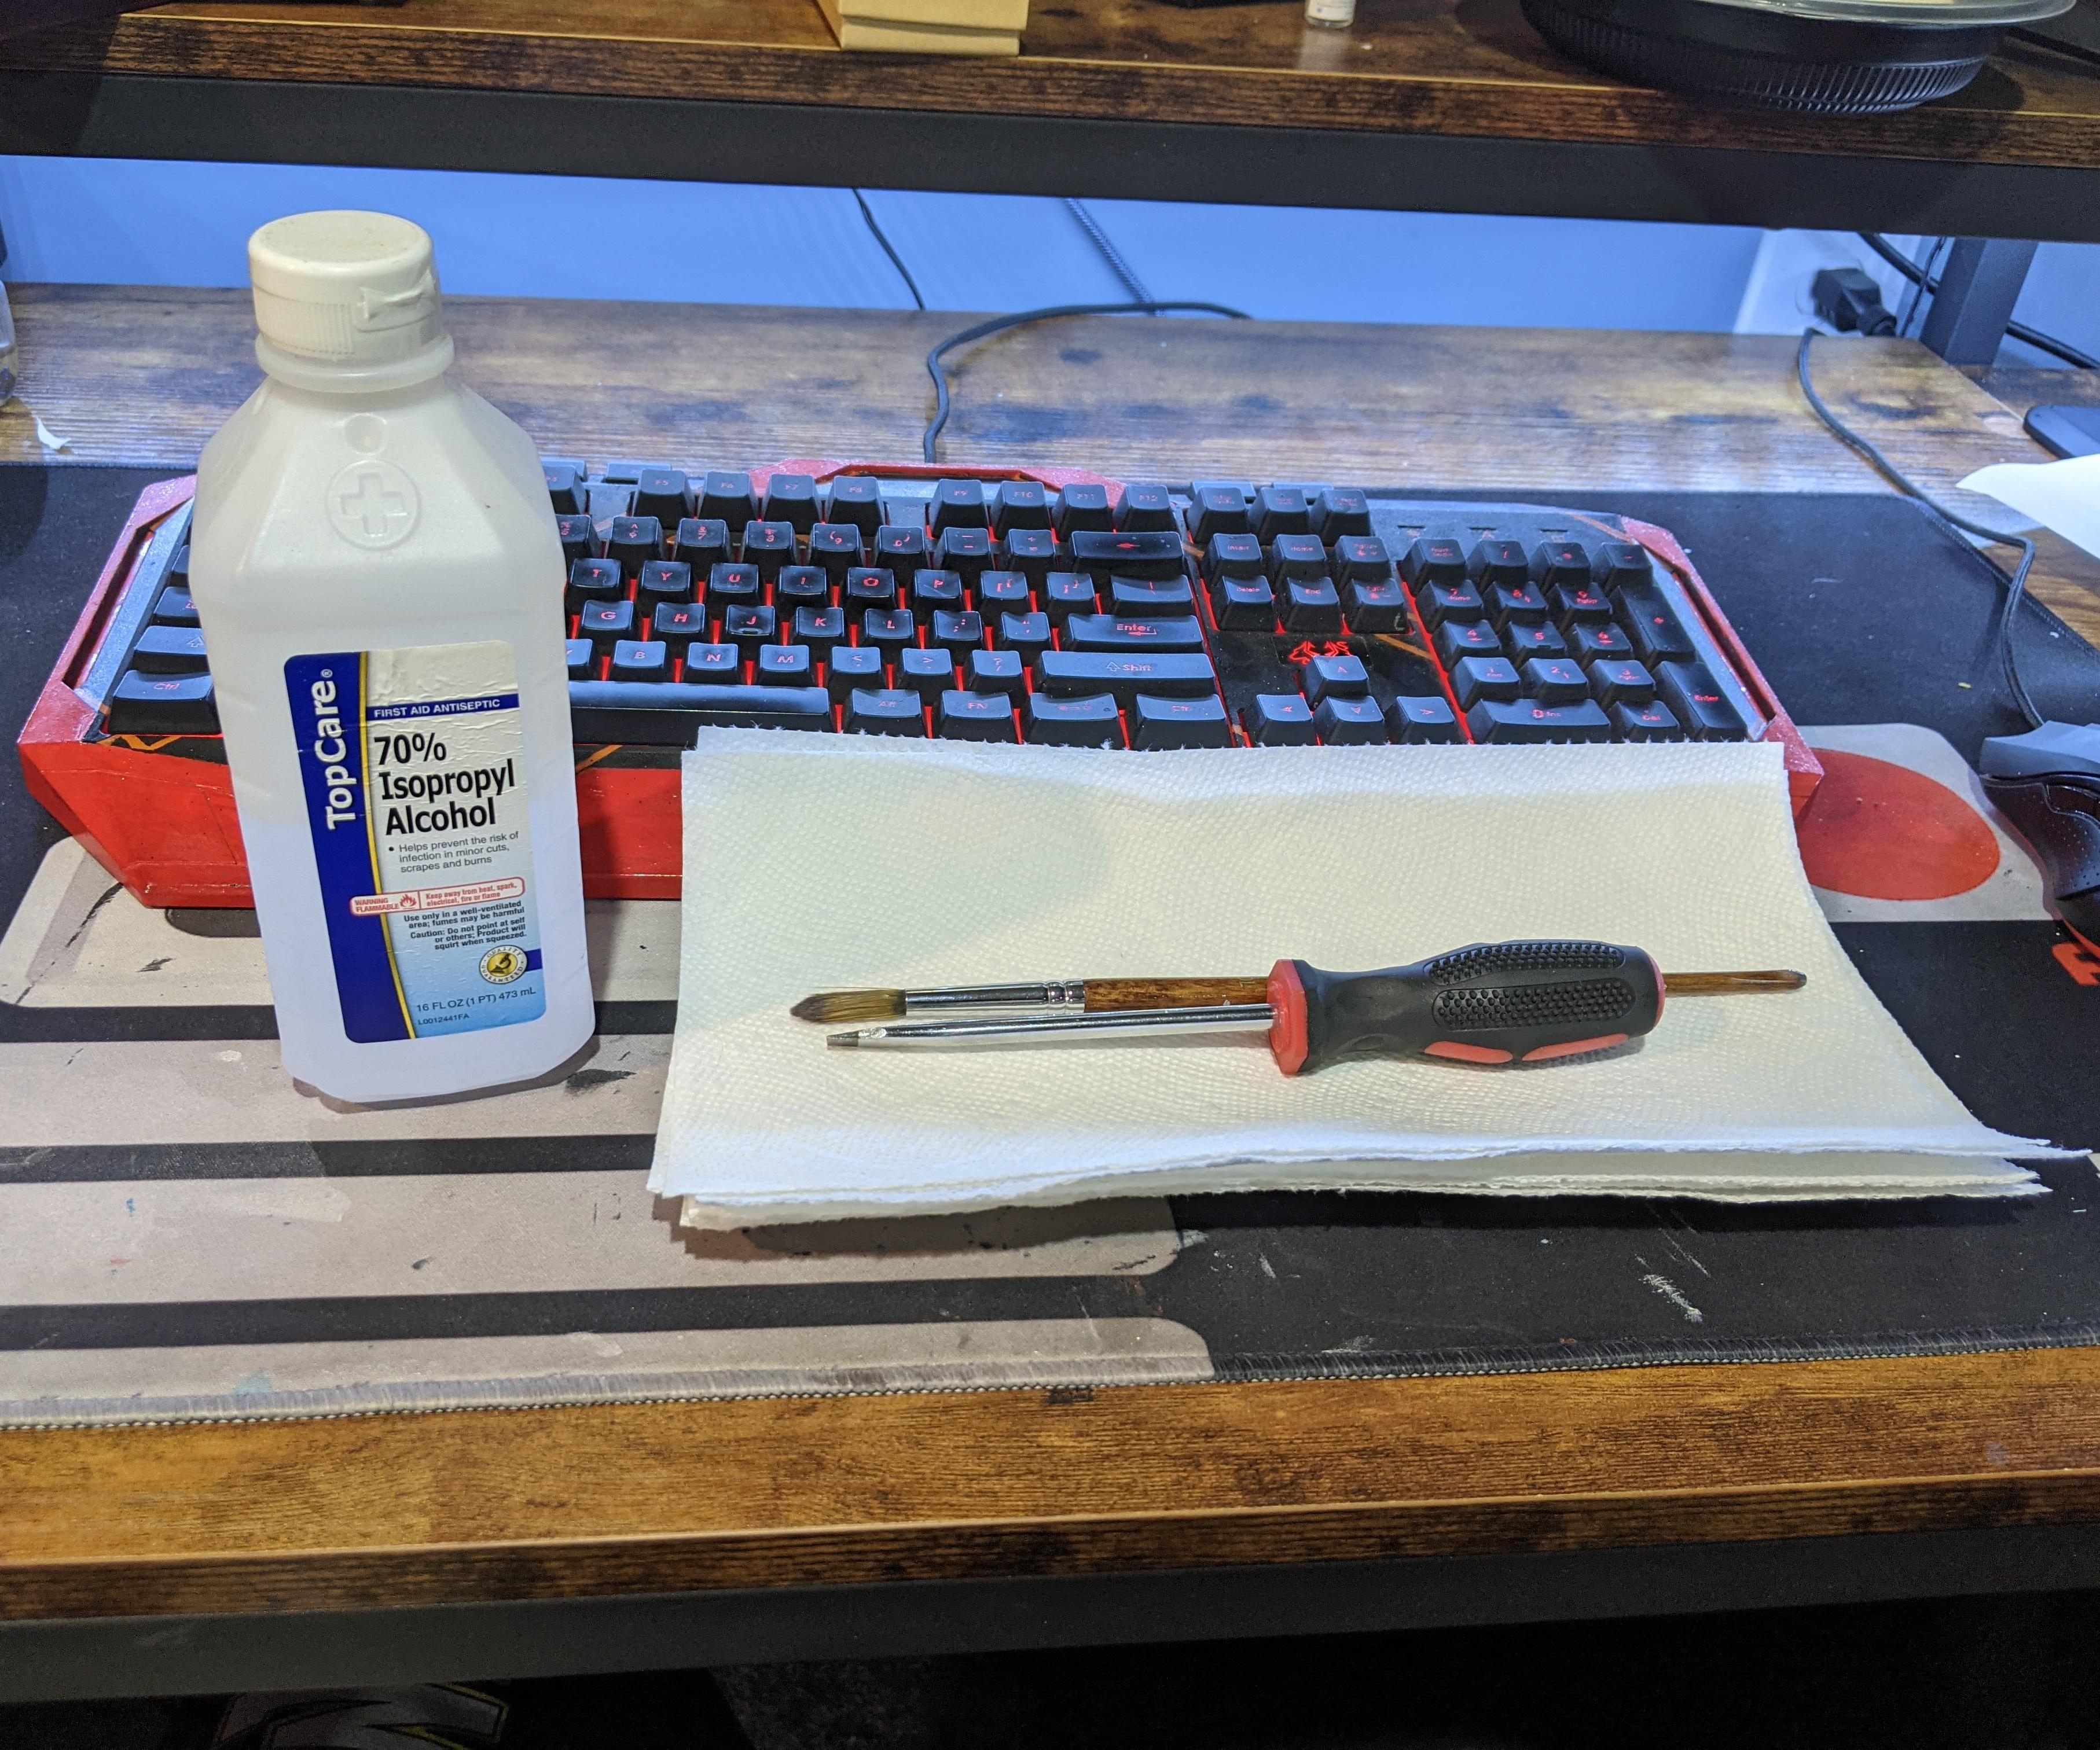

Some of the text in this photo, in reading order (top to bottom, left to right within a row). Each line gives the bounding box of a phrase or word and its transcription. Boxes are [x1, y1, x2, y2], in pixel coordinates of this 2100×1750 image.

[1116, 623, 1152, 632] Enter
[1123, 664, 1153, 672] Shift
[153, 682, 180, 690] Ctrl
[374, 698, 501, 718] FIRST AID ANTISEPTIC
[374, 732, 447, 765] 70%
[379, 758, 515, 804] Isopropyl
[386, 796, 496, 836] Alcohol
[399, 831, 520, 853] Helps prevent the risk of
[399, 844, 510, 863] infection in minor cuts,
[401, 855, 492, 873] scrapes and burns
[426, 892, 443, 900] Keep
[444, 890, 461, 898] away
[497, 882, 517, 892] spark,
[355, 898, 388, 906] WARNING
[355, 903, 400, 913] FLAMMABLE
[422, 912, 440, 921] only
[460, 900, 522, 916] well-ventilated
[427, 898, 460, 907] electrical,
[409, 921, 430, 929] area;
[432, 918, 458, 927] fumes
[461, 914, 478, 923] may
[493, 906, 525, 918] harmful
[410, 929, 445, 939] Caution:
[477, 922, 498, 932] point
[511, 917, 526, 925] self
[446, 932, 475, 942] others;
[477, 928, 509, 938] Product
[512, 924, 526, 932] will
[435, 931, 527, 951] squirt when squeezed.
[487, 947, 523, 958] QUALITY
[481, 964, 524, 982] GUARANTEED
[417, 987, 537, 1012] 16 FL OZ (1 PT) 473 mL
[417, 1013, 471, 1025] L0012441FA
